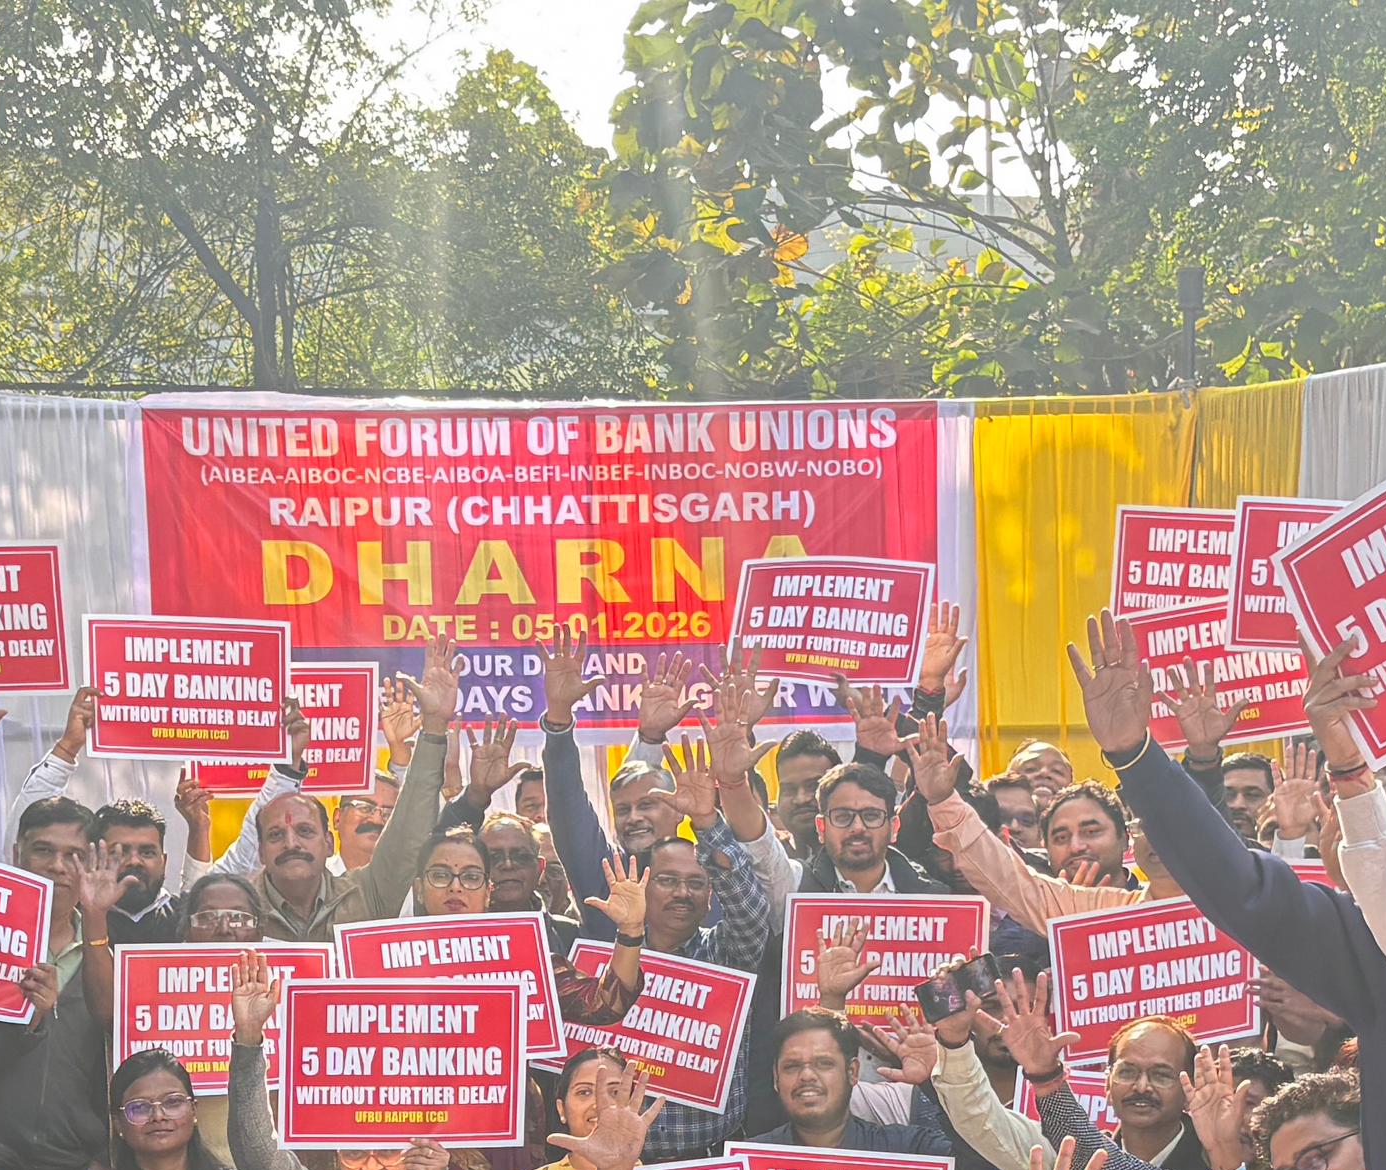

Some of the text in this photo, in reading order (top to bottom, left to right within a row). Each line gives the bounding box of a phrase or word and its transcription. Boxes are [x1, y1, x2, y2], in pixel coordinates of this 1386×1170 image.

[181, 406, 898, 458] UNITED FORUM OF BANK UNIONS
[201, 457, 883, 486] (AIBEA-AIBOC-NCBE-AIBOA-BEFI-INBEF-INBOC-NOBW-NOBO)
[268, 490, 816, 534] RAIPUR (CHHATTISGARH)
[1129, 561, 1185, 586] 5 DAY
[773, 575, 894, 602] IMPLEMENT
[382, 614, 478, 641] DATE
[511, 611, 712, 641] 0501.2026
[750, 606, 908, 636] 5 DAY BANKING
[8, 639, 54, 656] DELAY
[125, 637, 253, 665] IMPLEMENT
[806, 636, 909, 658] FURTHER DELAY
[105, 672, 272, 702] 5 DAY BANKING
[100, 705, 277, 726] WITHOUT FURTHER DELAY
[381, 934, 511, 970] IMPLEMENT
[1073, 950, 1240, 1000] 5 DAY BANKING
[136, 1005, 203, 1031] 5 DAY
[1070, 982, 1245, 1027] WITHOUT FURTHER DELAY
[327, 1005, 479, 1033] IMPLEMENT
[621, 1004, 722, 1050] BANKING
[302, 1047, 502, 1075] 5 DAY BANKING
[614, 1034, 720, 1075] FURTHER DELAY
[296, 1086, 507, 1105] WITHOUT FURTHER DELAY
[385, 1111, 423, 1122] RAIPUR
